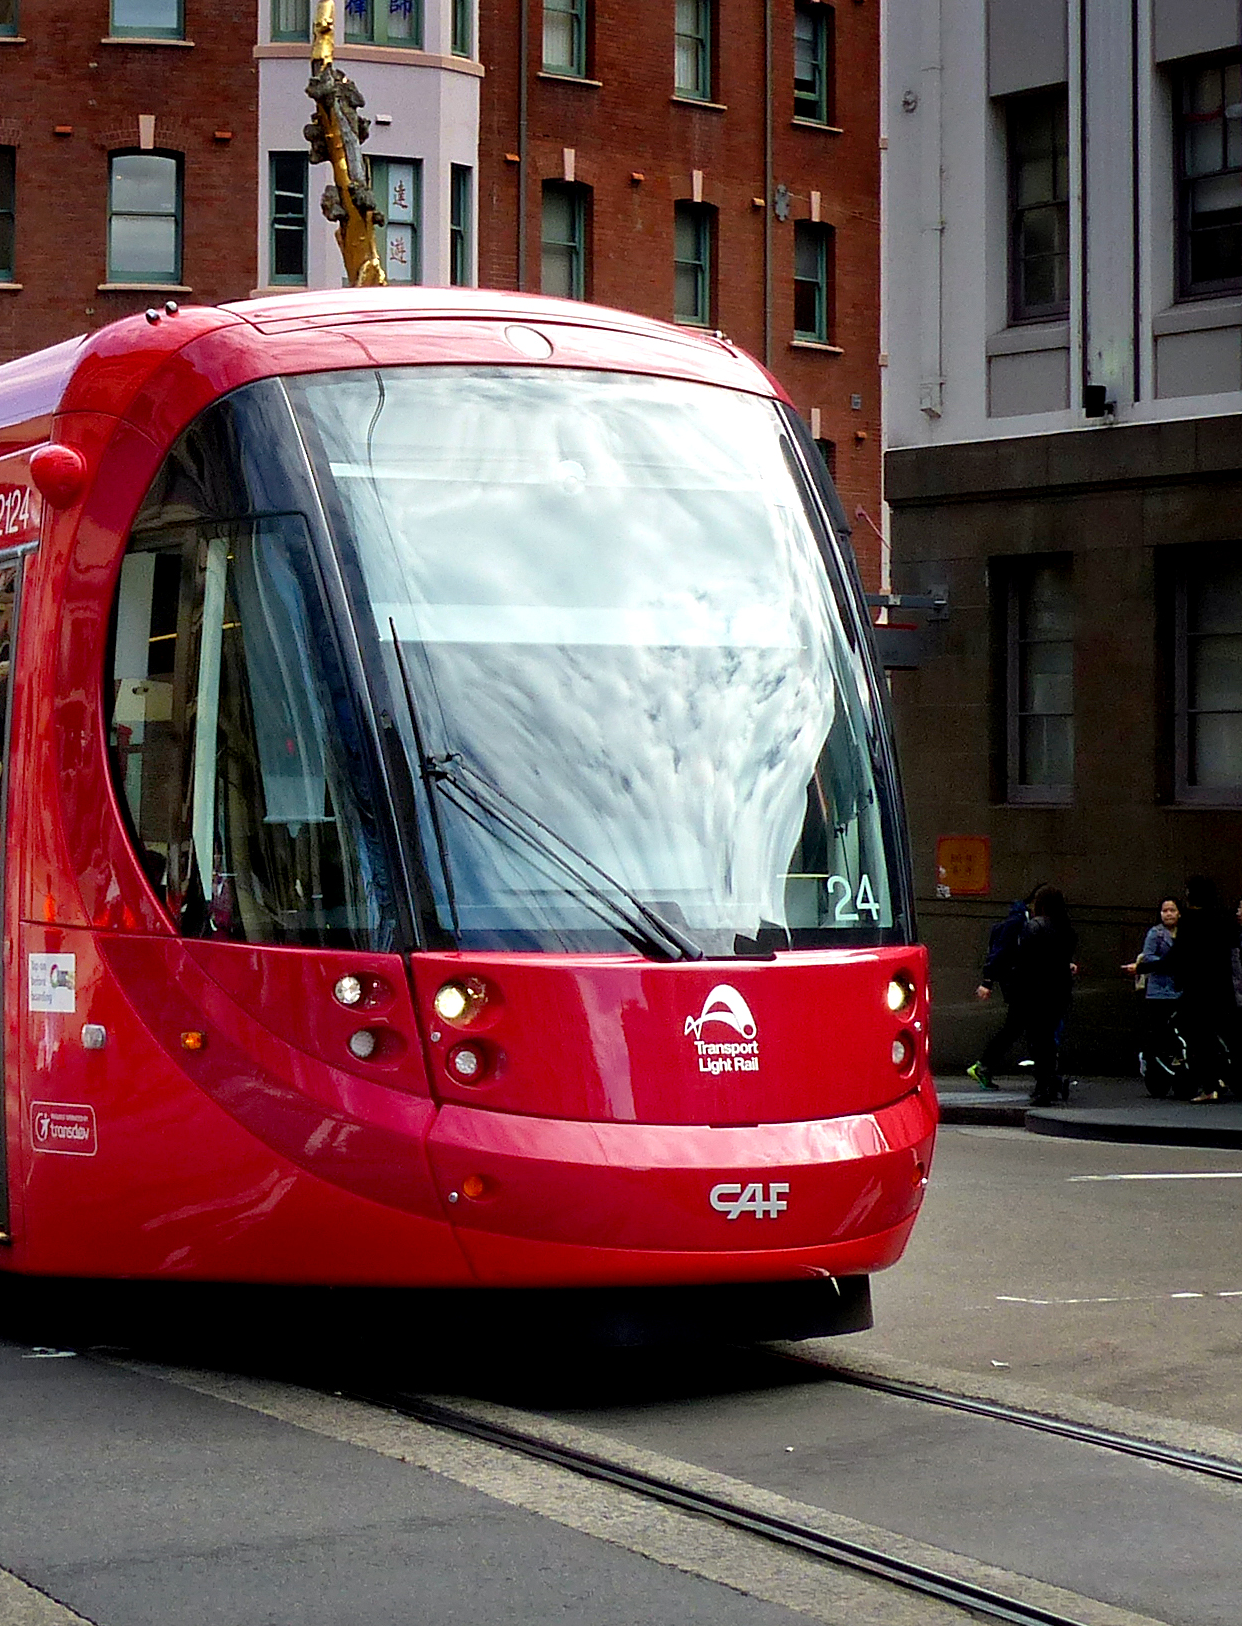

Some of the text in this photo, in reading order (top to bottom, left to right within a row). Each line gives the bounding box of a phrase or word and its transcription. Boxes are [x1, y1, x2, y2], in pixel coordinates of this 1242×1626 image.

[827, 874, 880, 921] 24
[694, 1040, 759, 1057] Transport
[699, 1057, 759, 1075] Light Rail
[50, 1122, 90, 1140] transdev
[709, 1183, 790, 1219] CAF
